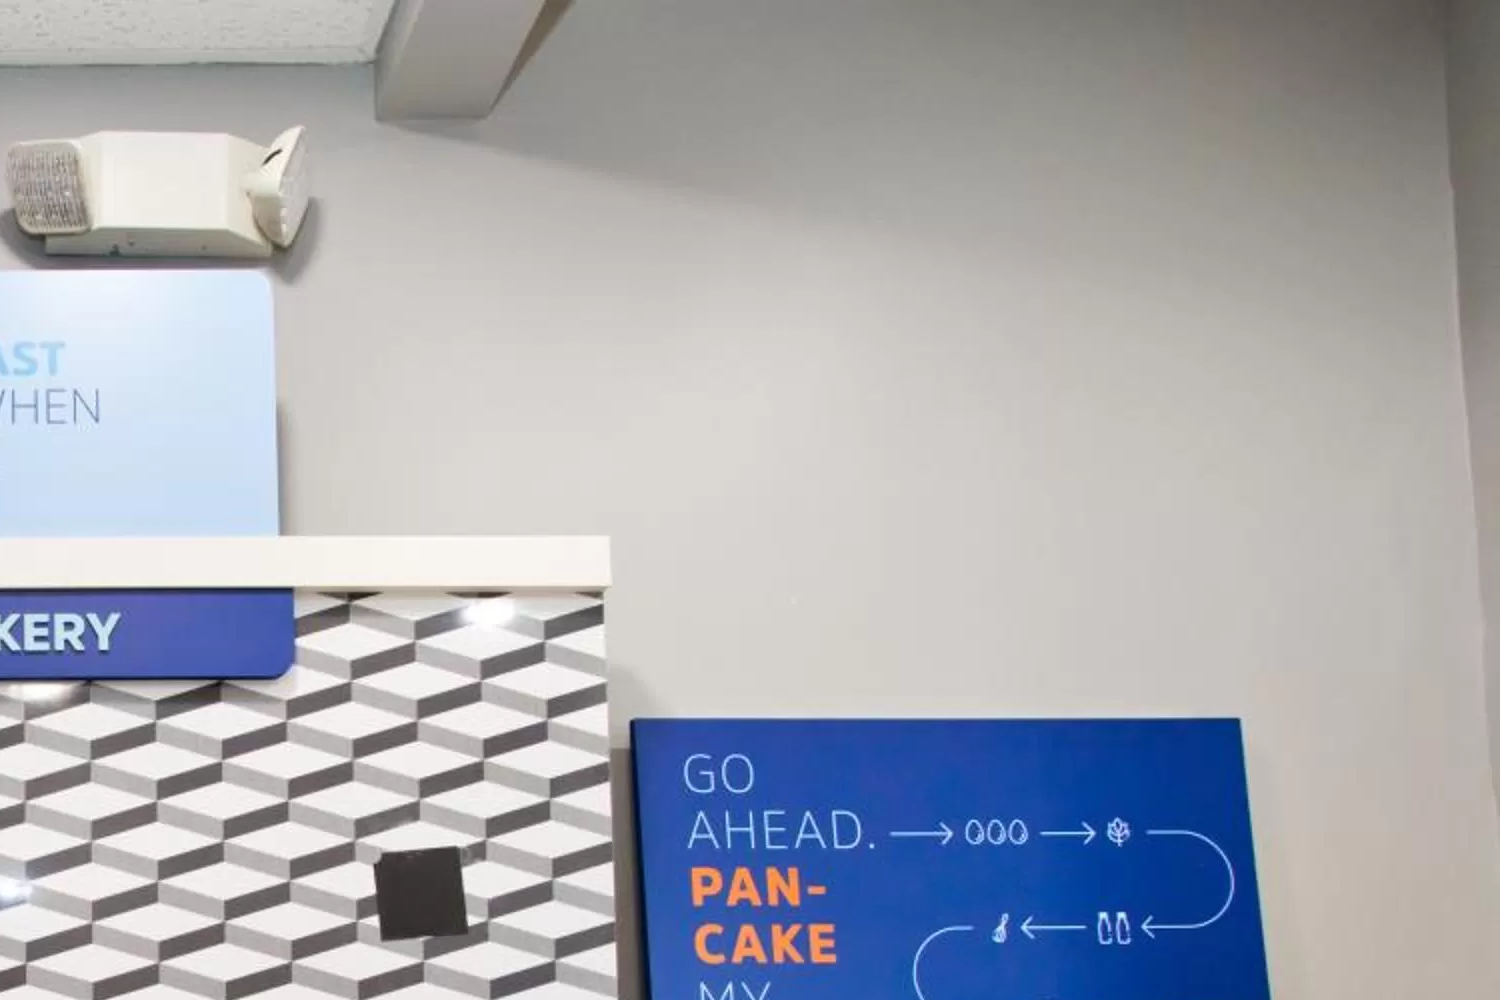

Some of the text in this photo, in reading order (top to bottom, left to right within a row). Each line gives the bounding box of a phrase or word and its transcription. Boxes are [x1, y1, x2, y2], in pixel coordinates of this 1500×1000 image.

[684, 753, 755, 794] GO
[687, 809, 875, 849] AHEAD.
[691, 866, 826, 907] PAN-
[694, 923, 837, 965] CAKE
